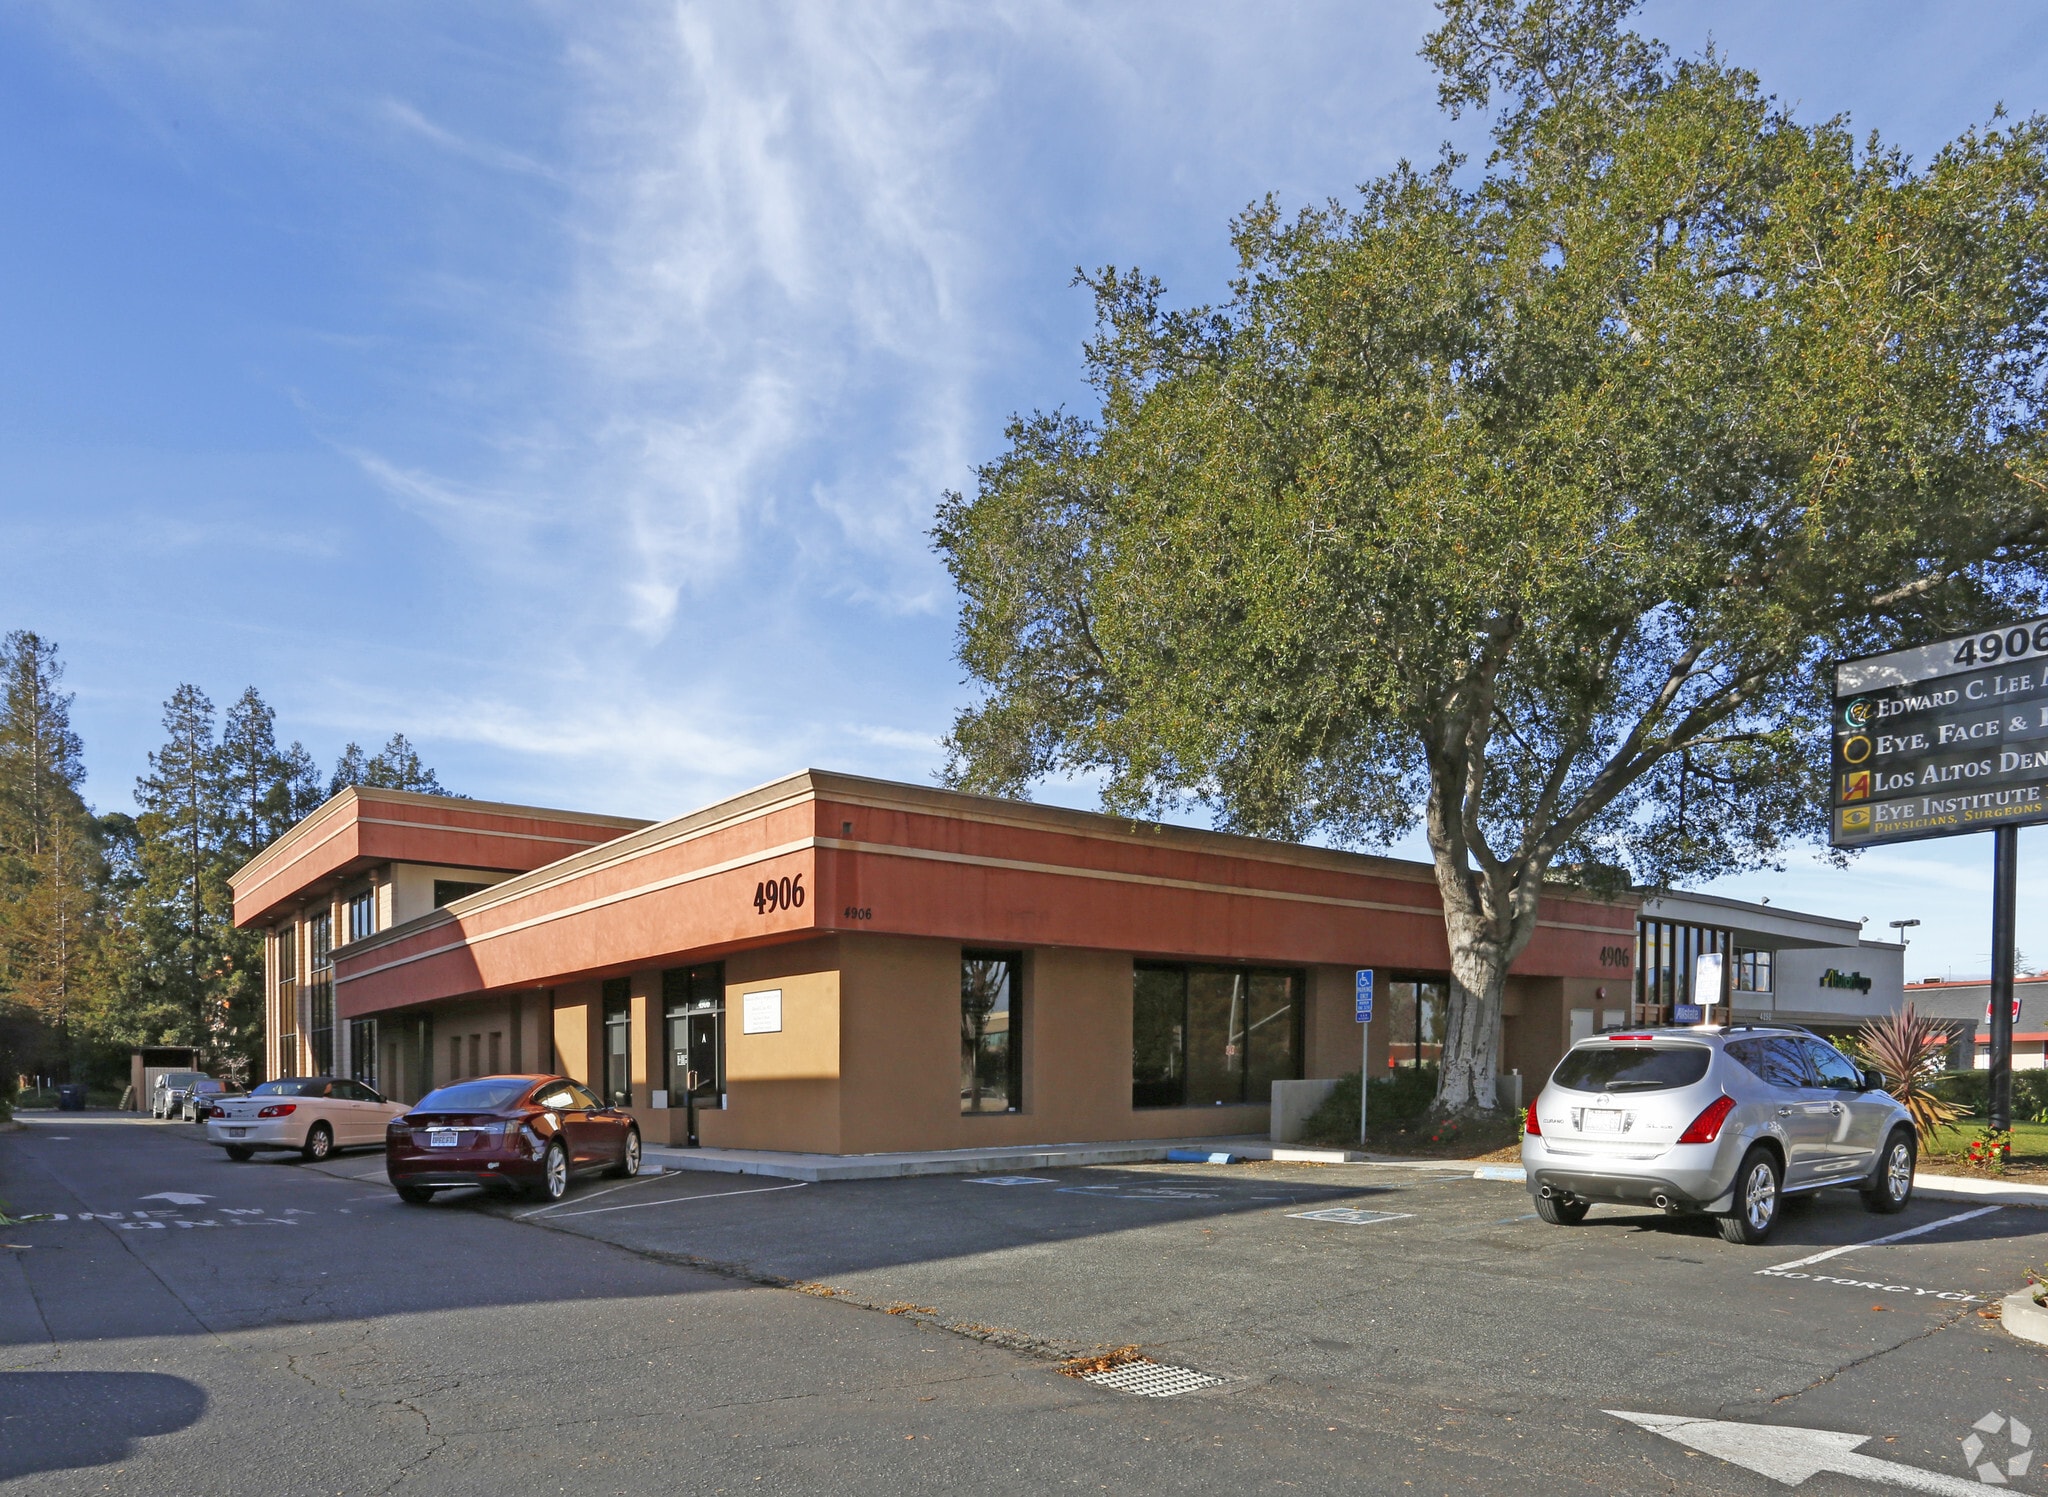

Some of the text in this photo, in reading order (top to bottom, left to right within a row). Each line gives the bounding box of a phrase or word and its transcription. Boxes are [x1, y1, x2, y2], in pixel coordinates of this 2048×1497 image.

[1954, 622, 2048, 667] 4906
[1876, 689, 1959, 719] EDWARD
[1965, 680, 1988, 700] C.
[1993, 675, 2035, 696] LEE,
[1875, 733, 1930, 756] EYE,
[1938, 720, 2000, 745] FACE
[2008, 716, 2028, 732] &
[1874, 772, 1914, 792] LOS
[1920, 760, 1992, 785] ALTOS
[1874, 803, 2042, 833] PHYSICIANS, SURGEONS
[1875, 803, 1914, 822] EYE
[1922, 786, 2040, 816] INSTITUTE
[753, 873, 805, 915] 4906
[843, 906, 872, 920] 4906
[1600, 946, 1629, 968] 4906
[1675, 1006, 1699, 1021] Allstate
[119, 1218, 298, 1230] ONLY
